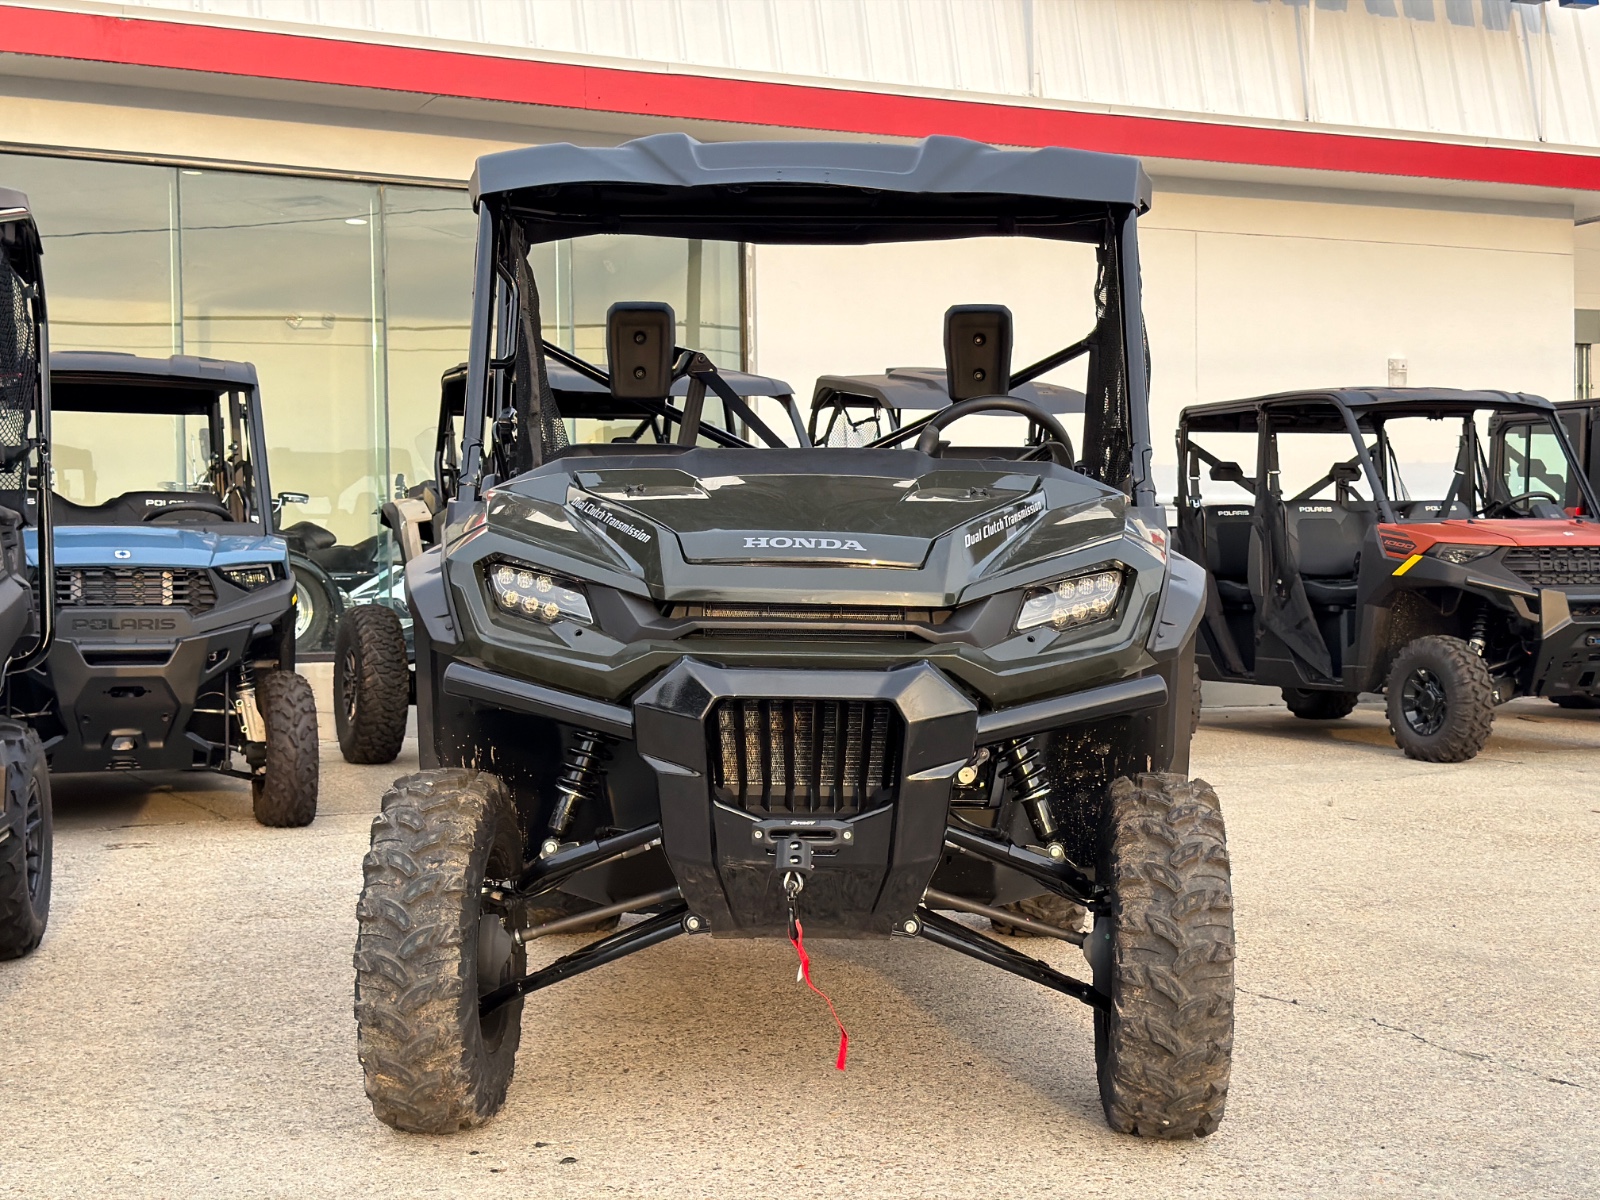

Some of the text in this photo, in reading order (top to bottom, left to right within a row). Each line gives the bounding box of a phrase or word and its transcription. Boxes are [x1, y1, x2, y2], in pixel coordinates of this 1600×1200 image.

[570, 496, 652, 544] Dual Clutch Transmission
[964, 500, 1042, 548] Dual Clutch Transmission
[743, 537, 867, 551] HONDA
[1384, 540, 1415, 549] 1000
[72, 618, 176, 630] POLARIS
